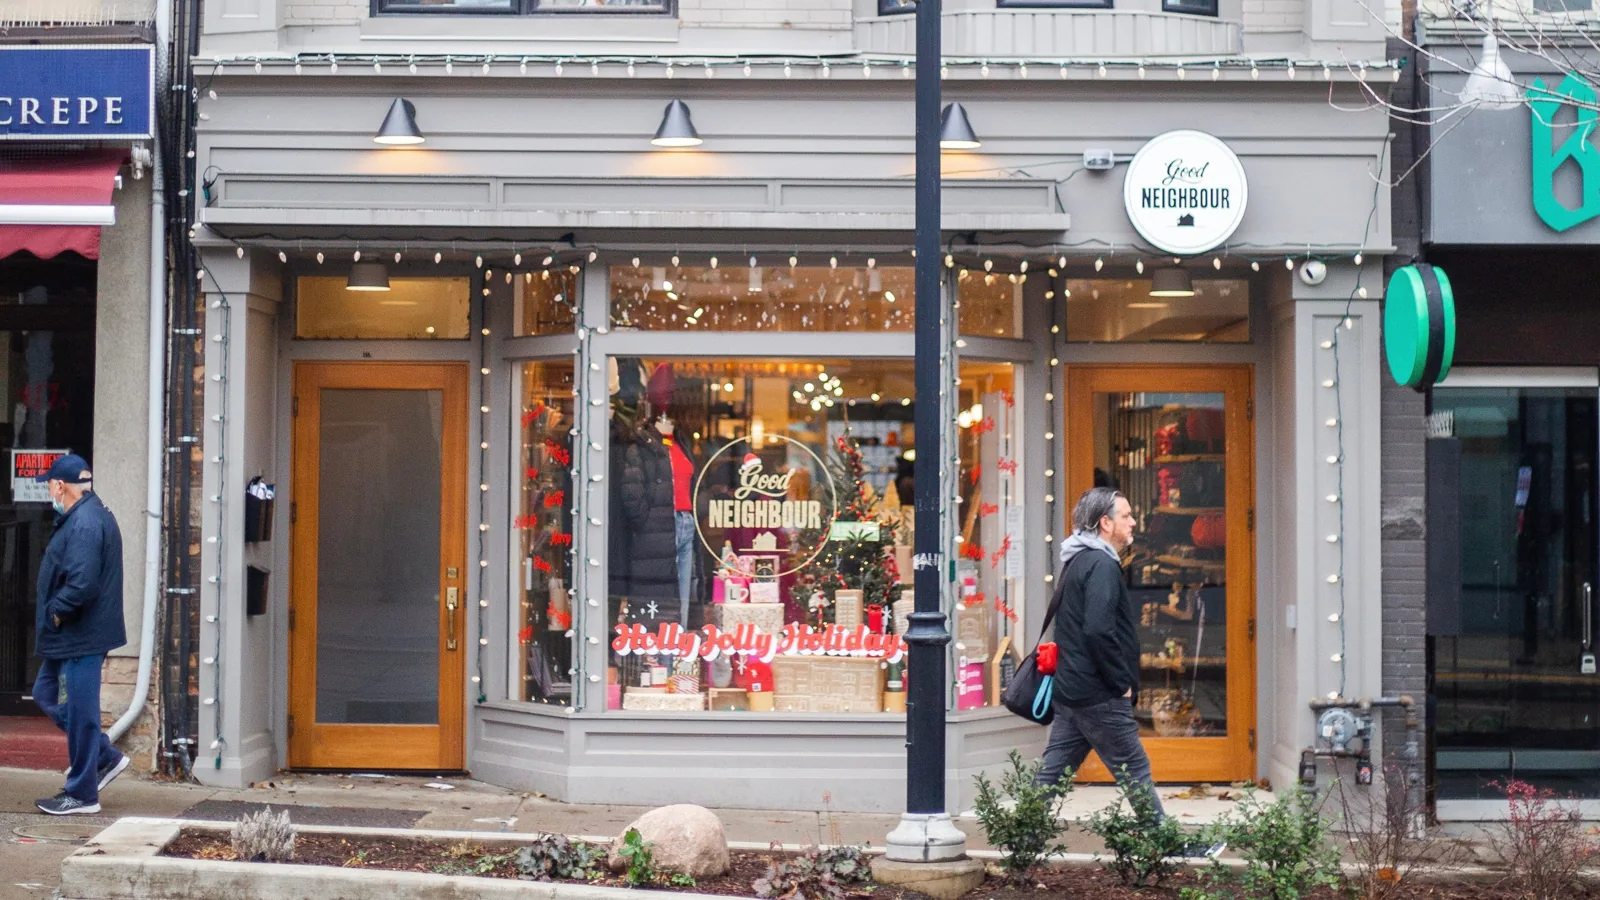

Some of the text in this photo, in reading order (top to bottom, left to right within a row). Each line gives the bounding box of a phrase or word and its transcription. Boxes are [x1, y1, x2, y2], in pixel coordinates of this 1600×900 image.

[1162, 158, 1210, 186] Good
[1141, 187, 1230, 209] NEIGHBOUR
[18, 469, 36, 477] FOR
[734, 463, 796, 499] Good
[708, 499, 822, 529] NEIGHBOUR
[611, 622, 701, 662] Holly
[699, 622, 777, 663] Jolly
